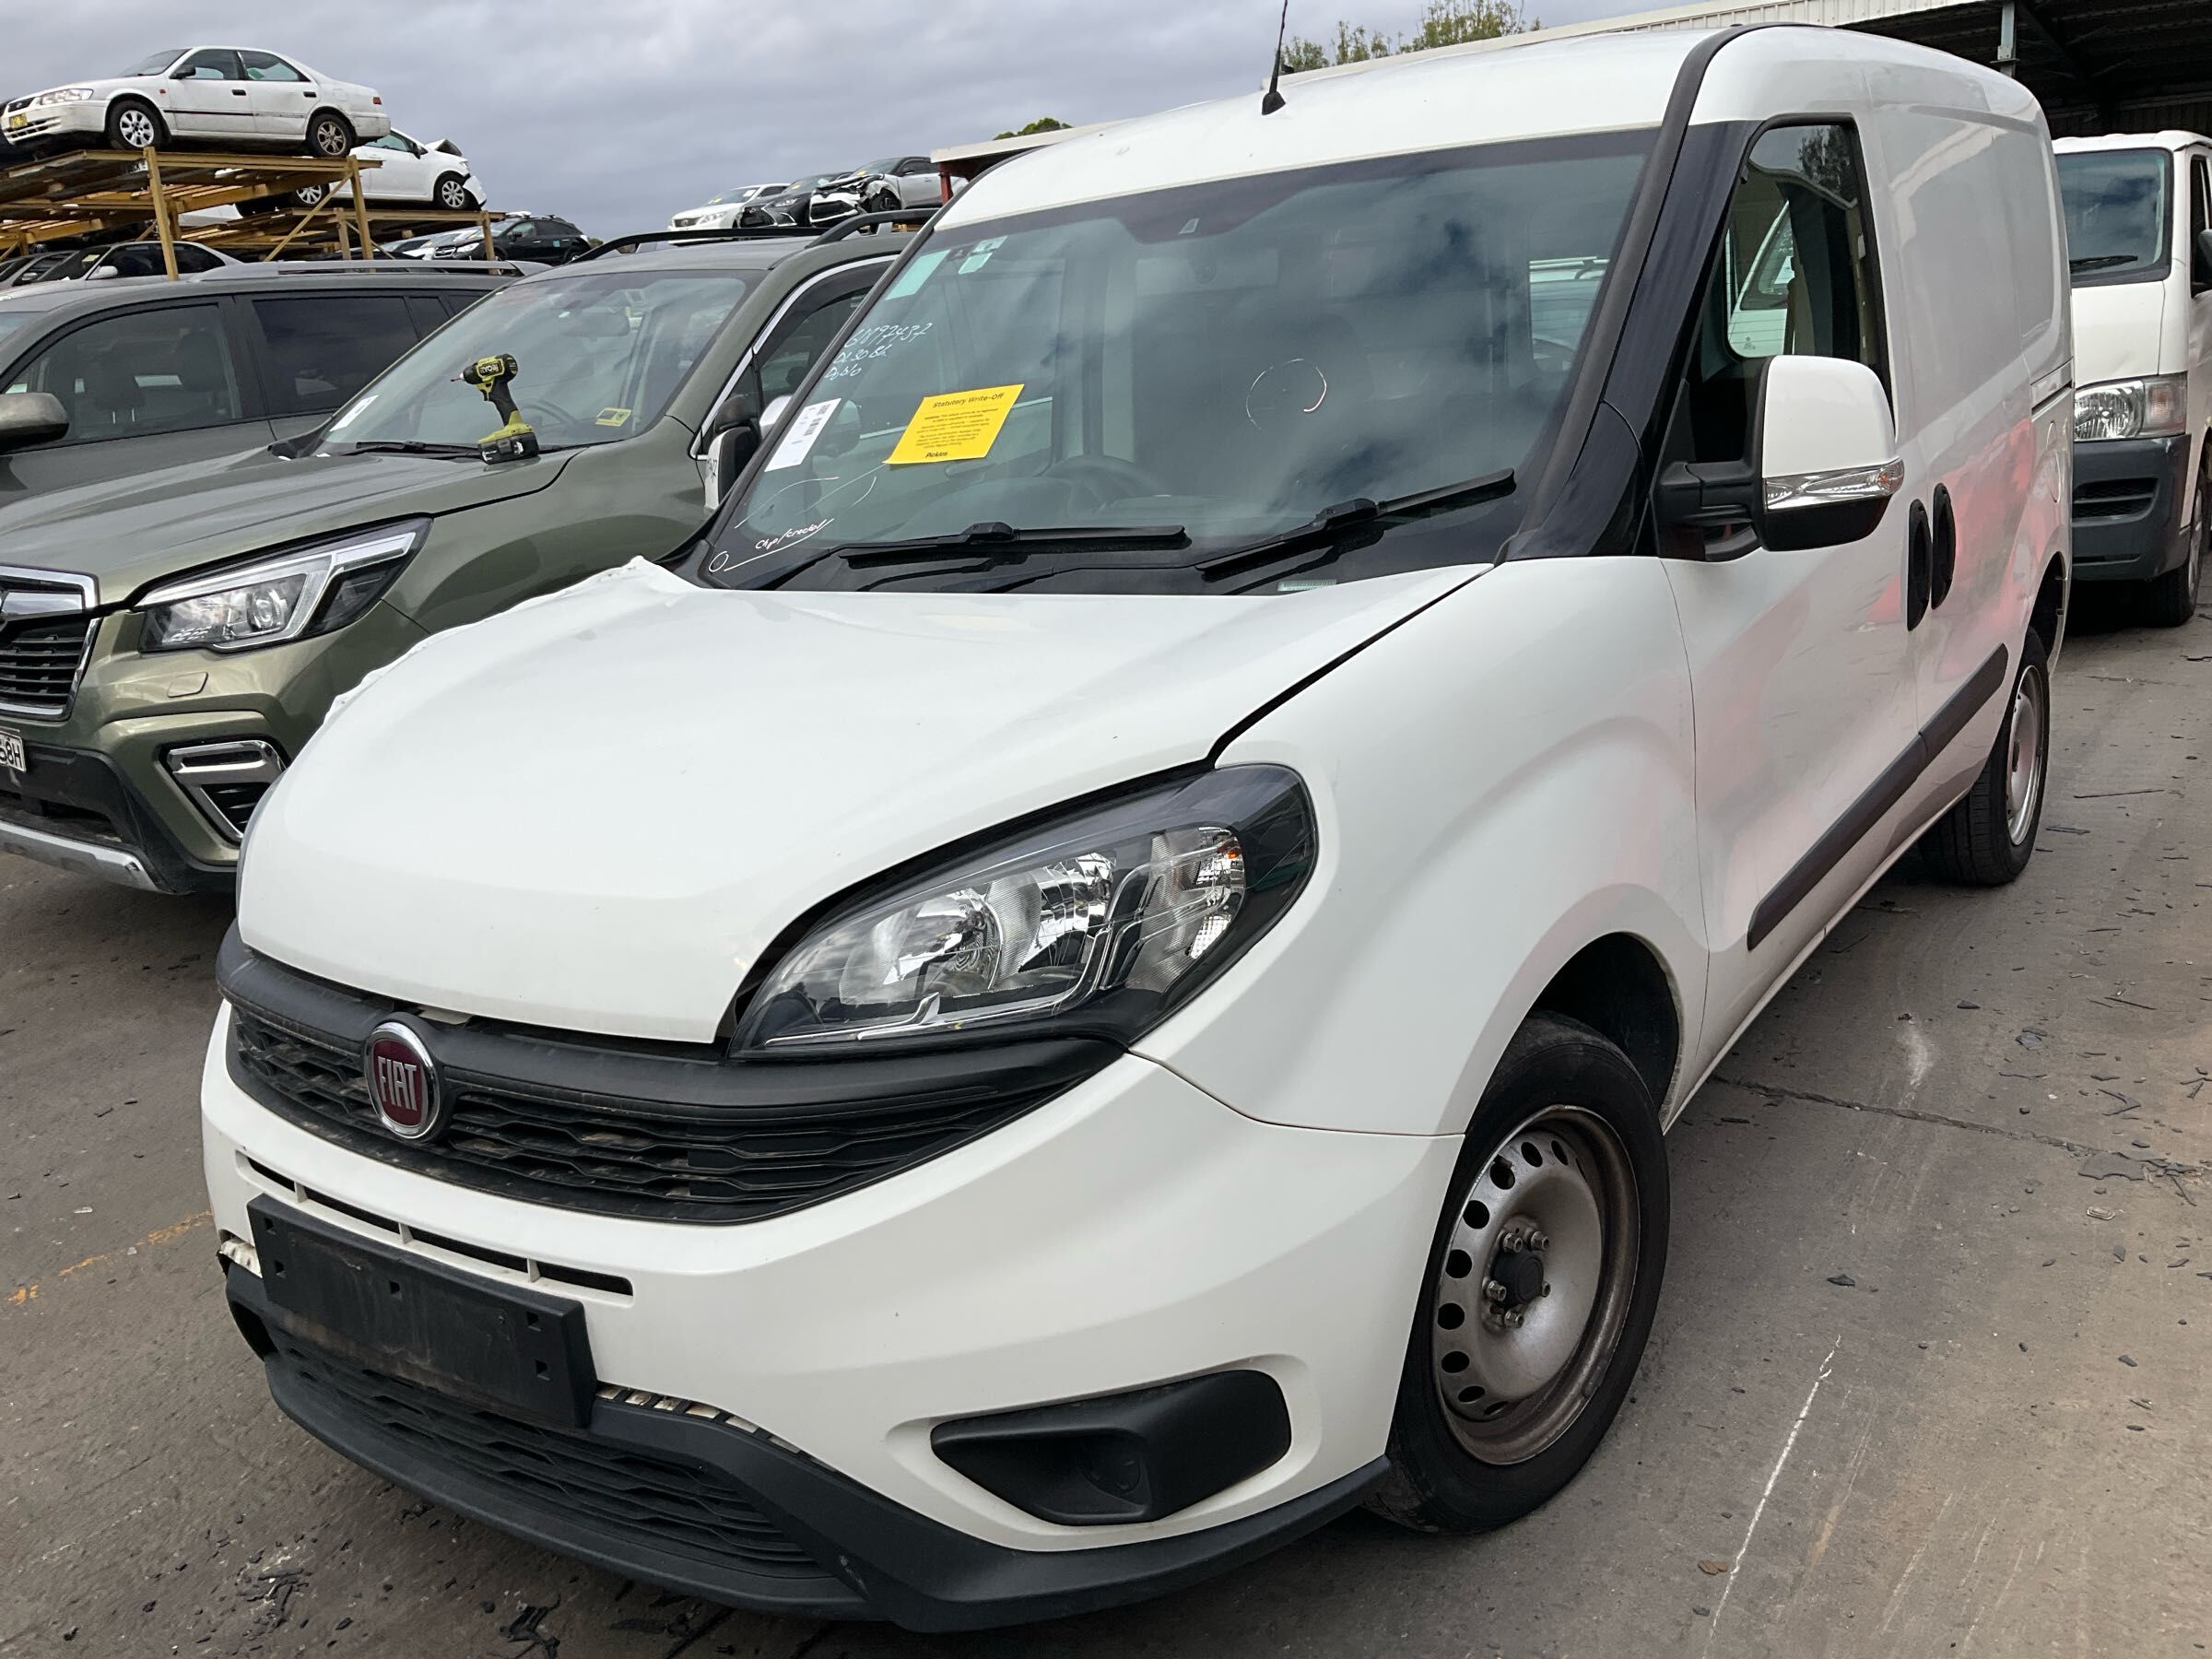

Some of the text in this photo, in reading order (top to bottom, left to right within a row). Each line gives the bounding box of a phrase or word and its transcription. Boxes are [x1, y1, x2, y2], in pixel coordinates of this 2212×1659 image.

[933, 392, 1005, 408] Statutory Write-Off
[378, 1055, 418, 1112] FIAT
